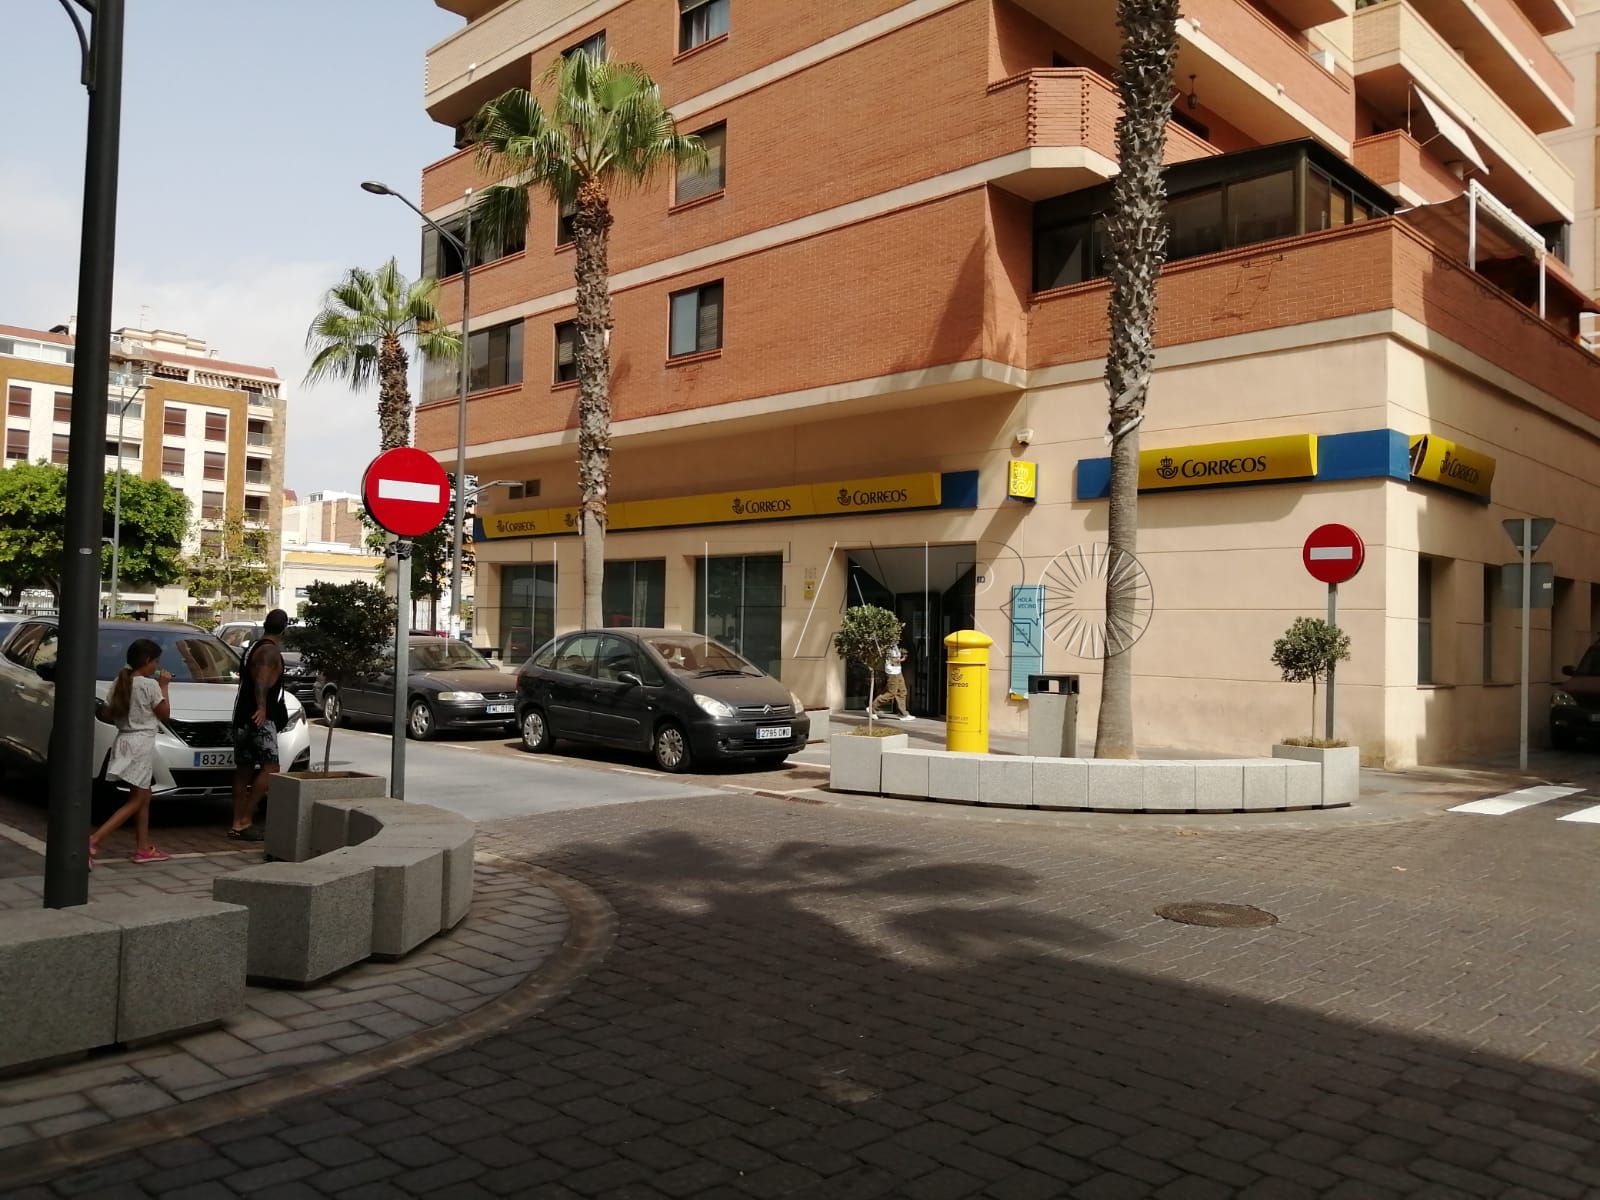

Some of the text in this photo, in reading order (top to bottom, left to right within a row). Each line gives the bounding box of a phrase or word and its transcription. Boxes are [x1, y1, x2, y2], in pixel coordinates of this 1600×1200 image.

[1182, 456, 1267, 478] CORREOS
[852, 489, 908, 505] CORREOS
[745, 499, 792, 514] CORREOS
[505, 520, 536, 532] CORREOS
[202, 754, 233, 766] 8324
